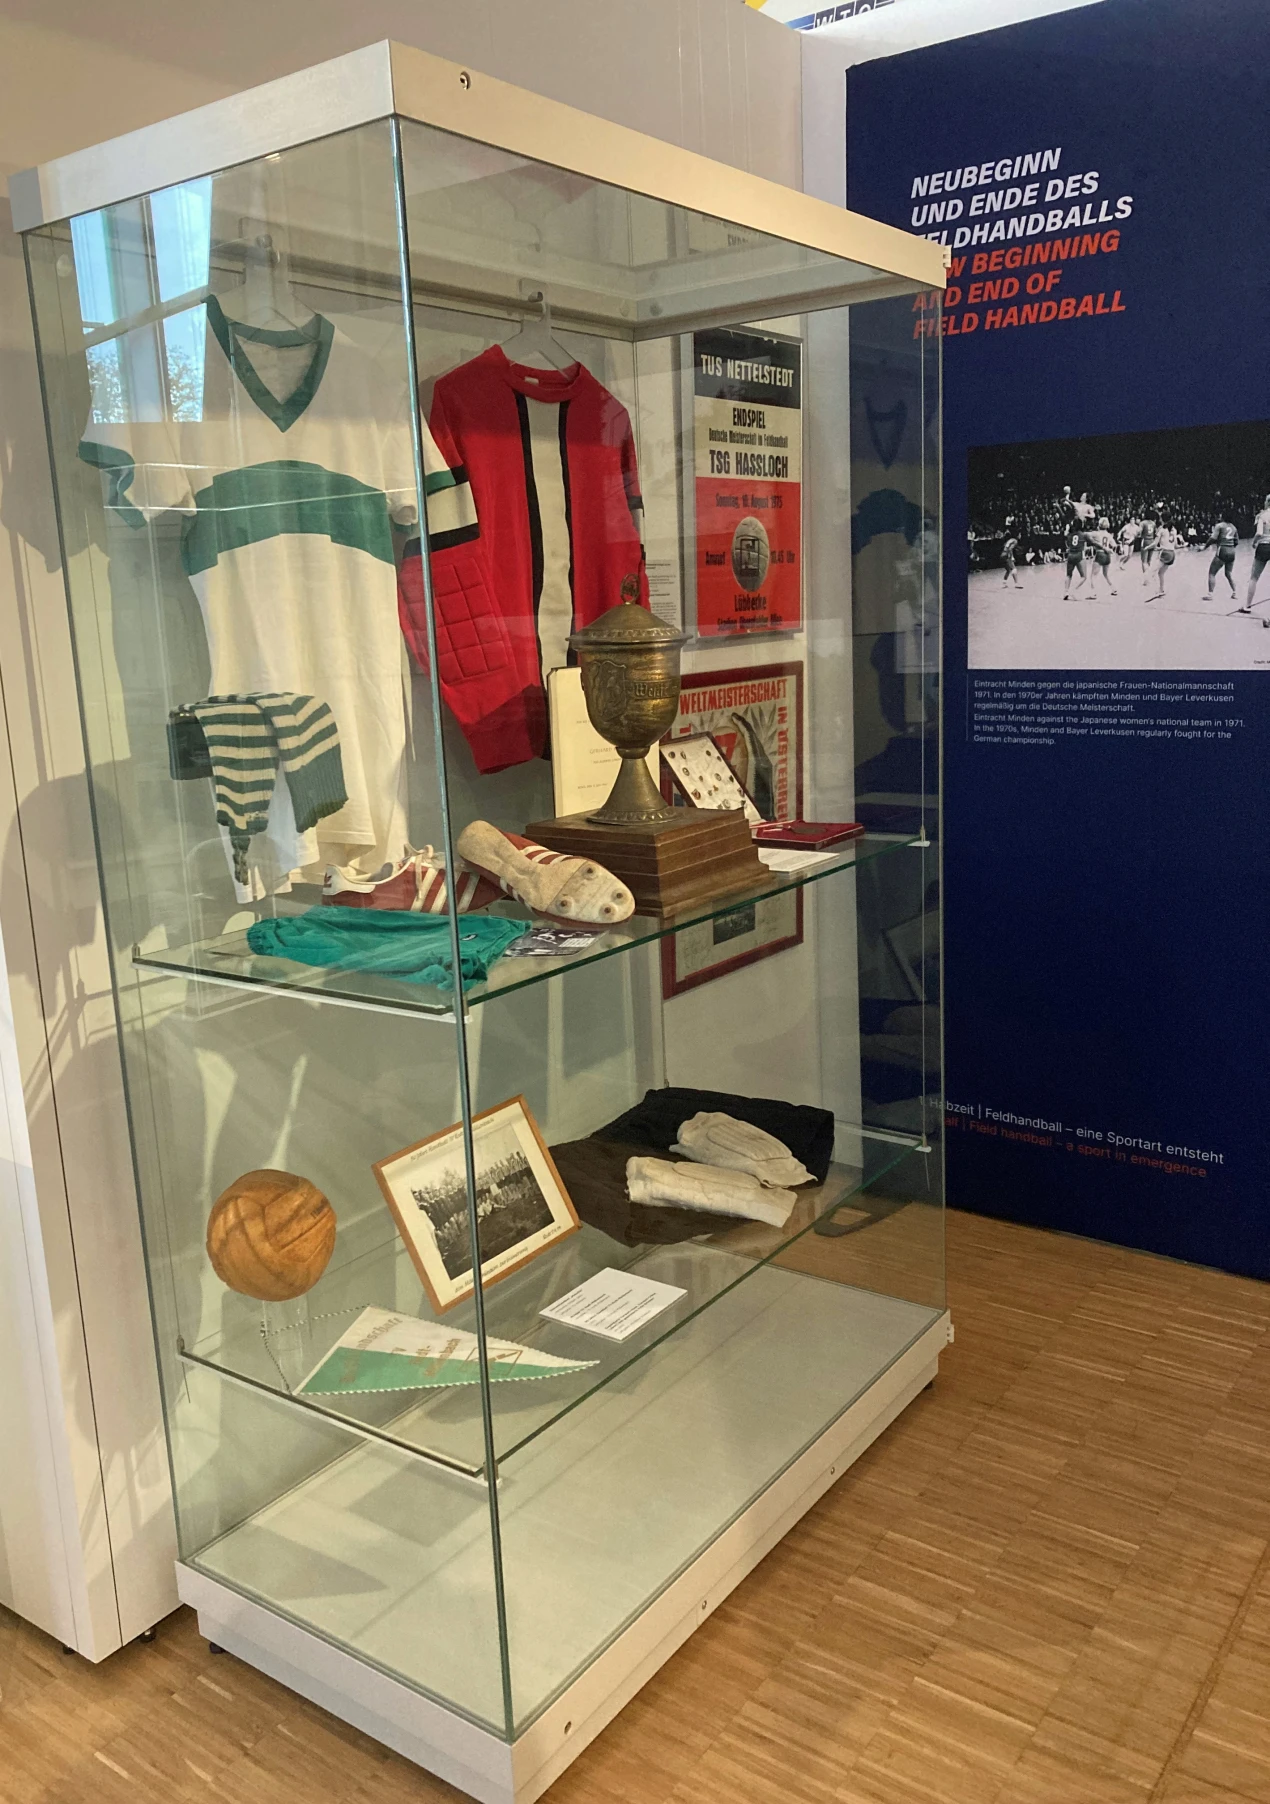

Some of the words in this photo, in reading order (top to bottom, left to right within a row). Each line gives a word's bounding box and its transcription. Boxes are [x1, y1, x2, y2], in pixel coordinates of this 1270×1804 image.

[910, 147, 1061, 199] NEUBEGINN
[911, 199, 964, 227] UND
[968, 183, 1040, 217] ENDE
[1045, 171, 1099, 202] DES
[971, 229, 1121, 275] BEGINNING
[967, 276, 1020, 304] END
[1026, 269, 1063, 294] OF
[912, 307, 979, 340] FIELD
[984, 290, 1127, 330] HANDBALL
[700, 354, 723, 377] TUS
[727, 358, 794, 388] NETTELSTEDT
[732, 407, 766, 429] ENDSPIEL
[709, 449, 731, 474] TSG
[735, 451, 788, 478] HASSLOCH
[679, 678, 788, 716] WELTMEISTERSCHAFT
[974, 680, 1006, 689] Eintracht
[1008, 680, 1035, 689] Minden
[1037, 682, 1060, 690] gegen
[1062, 681, 1074, 689] die
[1076, 681, 1118, 691] japanische
[1119, 682, 1234, 690] Frauen-Nationalmannschaft
[974, 691, 992, 699] 1971.
[993, 691, 1001, 699] In
[1002, 691, 1016, 699] den
[1072, 691, 1109, 701] kämpften
[1142, 693, 1158, 701] und
[1160, 693, 1183, 702] Bayer
[1185, 694, 1234, 702] Leverkusen
[777, 705, 788, 725] IN
[973, 702, 1014, 711] regelmäßig
[1029, 702, 1041, 710] die
[1042, 703, 1078, 711] Deutsche
[1080, 703, 1136, 712] Meisterschaft.
[974, 713, 1006, 721] Eintracht
[1008, 714, 1035, 722] Minden
[1036, 714, 1064, 723] against
[1066, 715, 1078, 723] the
[1080, 716, 1118, 725] Japanese
[1156, 717, 1189, 726] national
[1214, 719, 1222, 727] in
[1224, 719, 1246, 727] 1971.
[974, 724, 981, 732] In
[982, 724, 994, 732] the
[1021, 725, 1048, 733] Minden
[1050, 726, 1065, 734] and
[1066, 726, 1088, 735] Bayer
[1090, 728, 1135, 736] Leverkusen
[1137, 729, 1172, 738] regularly
[1174, 729, 1201, 739] fought
[1203, 730, 1215, 739] for
[1217, 731, 1232, 739] the
[969, 1120, 998, 1135] Field
[1001, 1127, 1053, 1147] handball
[1066, 1142, 1074, 1151] a
[1078, 1144, 1111, 1159] sport
[1115, 1151, 1126, 1162] in
[1130, 1154, 1207, 1178] emergence
[985, 1108, 1062, 1133] Feldhandball
[1076, 1126, 1103, 1141] eine
[1107, 1131, 1162, 1153] Sportart
[1166, 1145, 1224, 1165] entsteht
